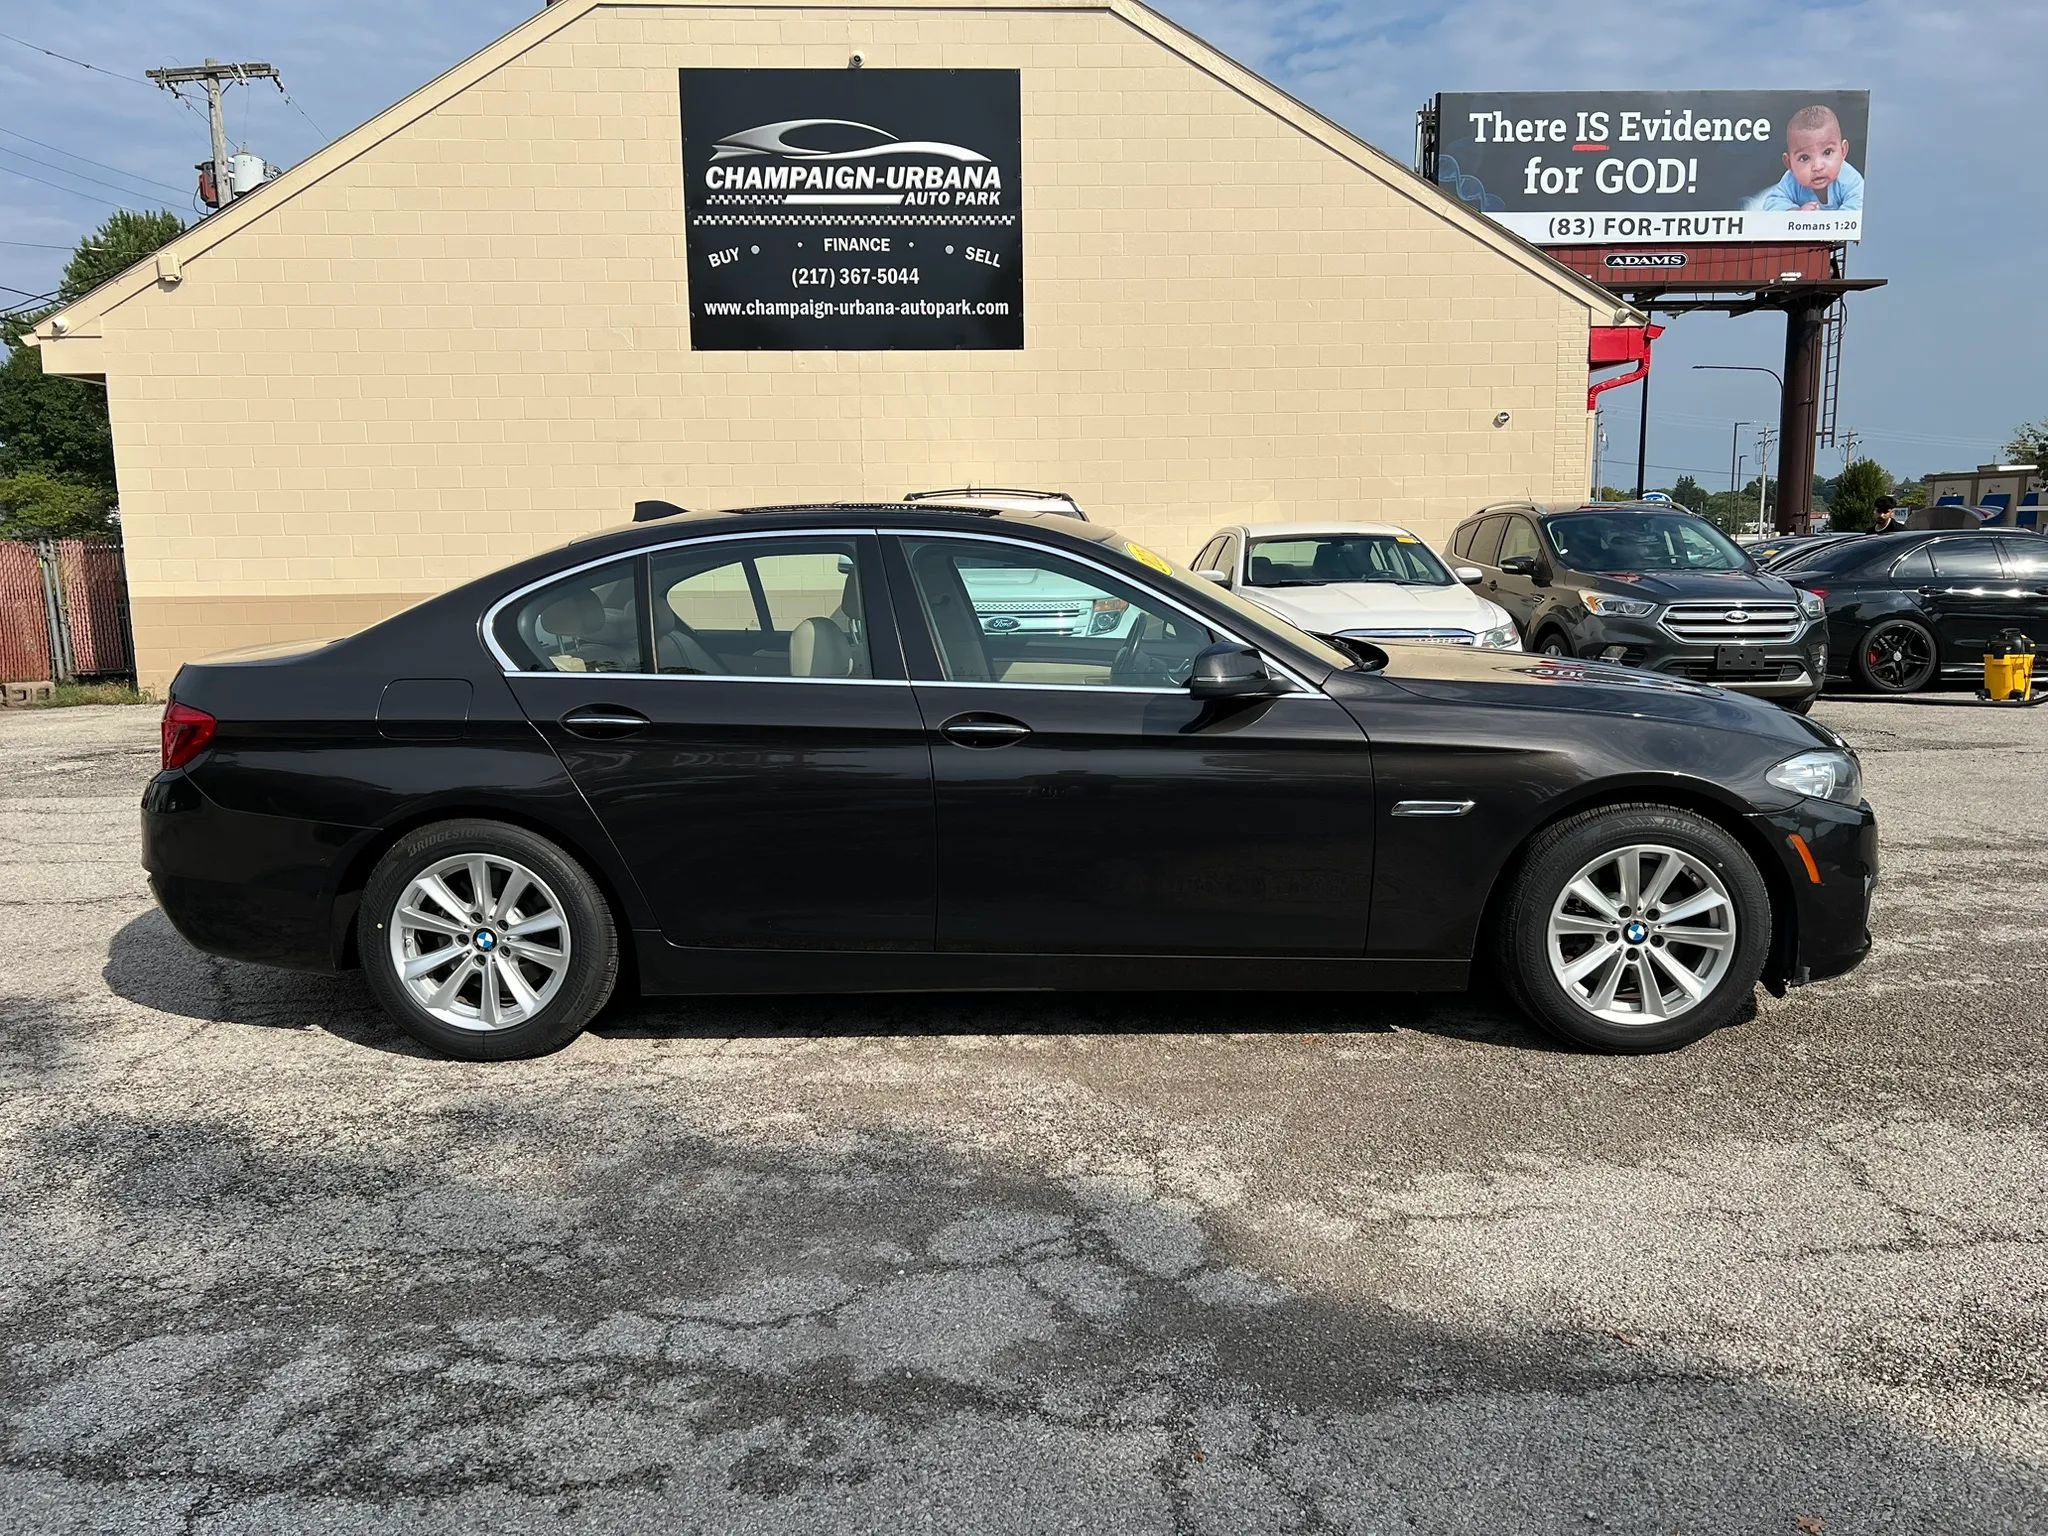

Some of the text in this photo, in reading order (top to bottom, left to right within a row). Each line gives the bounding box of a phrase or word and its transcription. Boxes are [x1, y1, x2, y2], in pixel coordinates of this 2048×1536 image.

[1469, 109, 1771, 144] There IS Evidence
[705, 165, 1002, 190] CHAMPAIGN-URBANA
[1523, 156, 1698, 195] for GOD!
[904, 191, 1001, 206] AUTO PARK
[1548, 216, 1744, 239] (83) FOR-TRUTH
[1787, 220, 1857, 231] Romans 1:20
[823, 237, 891, 252] FINANCE
[707, 246, 740, 268] BUY
[964, 246, 1001, 268] SELL
[1611, 256, 1682, 265] ADAMS
[791, 267, 920, 289] (217) 367-5044
[703, 298, 1009, 319] www.champaign-urbana-autopark.com
